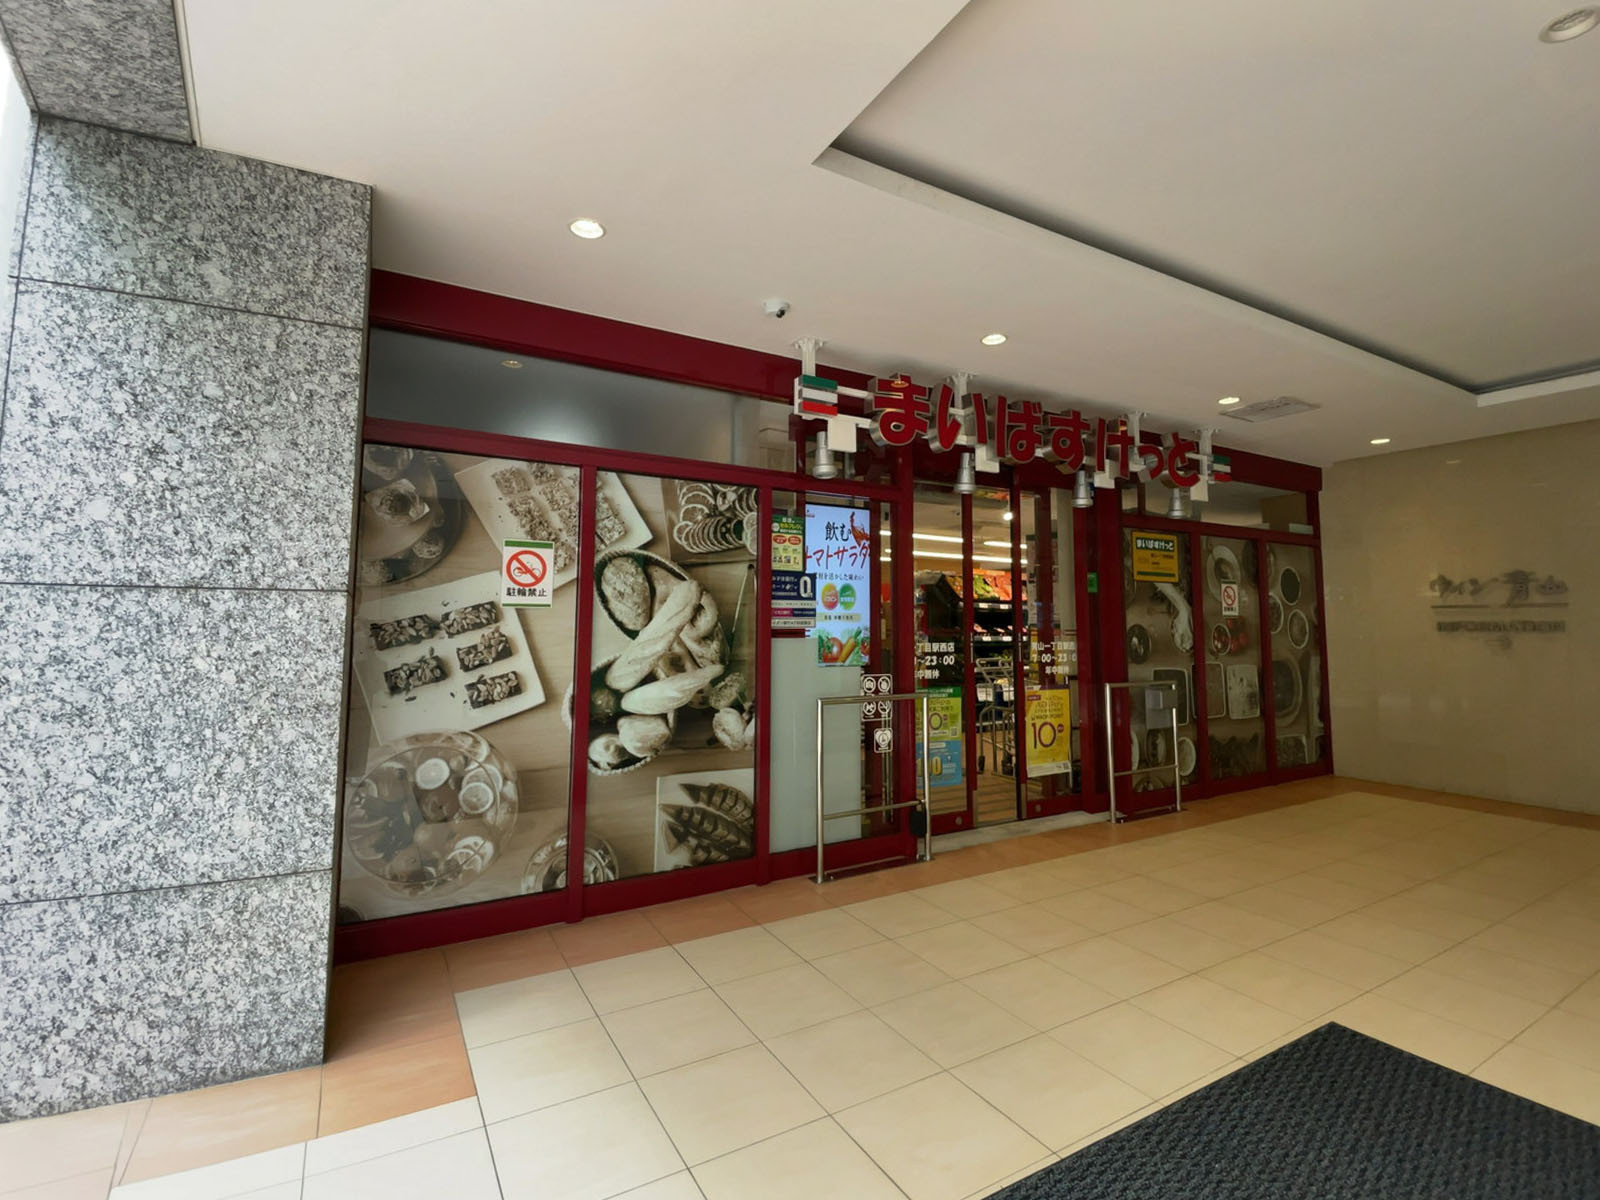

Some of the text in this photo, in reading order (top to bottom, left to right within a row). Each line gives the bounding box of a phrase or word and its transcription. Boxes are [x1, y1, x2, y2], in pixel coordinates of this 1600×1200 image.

[872, 374, 1200, 487] まいばすけっと
[825, 521, 851, 542] 飲む
[506, 587, 547, 597] 駐輪禁止
[914, 642, 954, 652] 丁目駅西店
